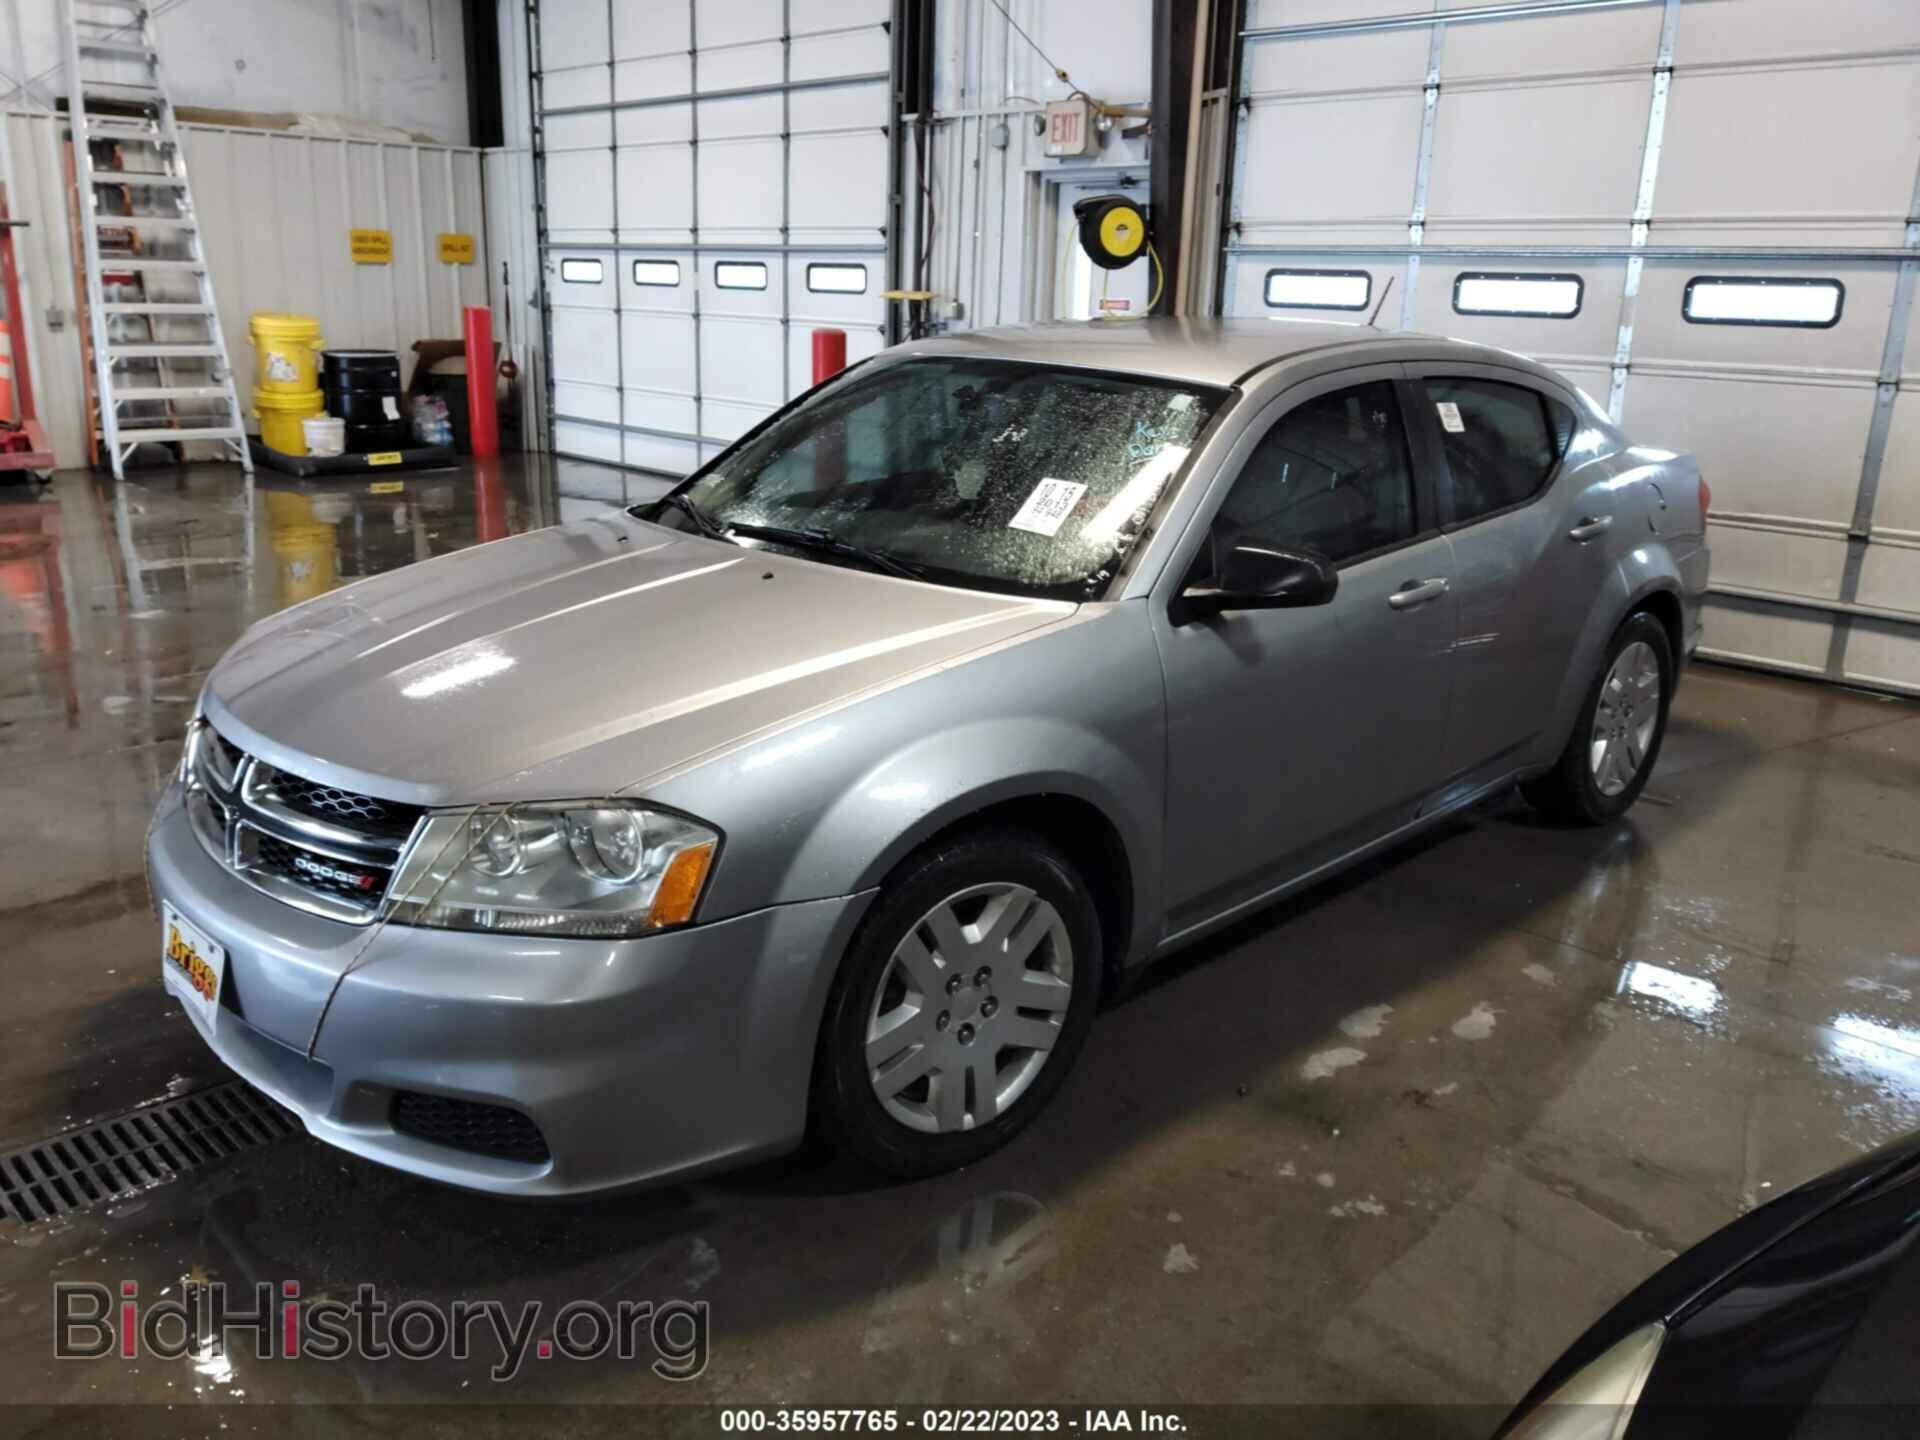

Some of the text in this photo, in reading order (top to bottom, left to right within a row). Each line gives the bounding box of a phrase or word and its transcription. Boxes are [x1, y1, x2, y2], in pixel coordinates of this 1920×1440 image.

[1052, 112, 1081, 144] EXIT
[295, 857, 361, 885] DODGE
[167, 923, 218, 1002] Briggs
